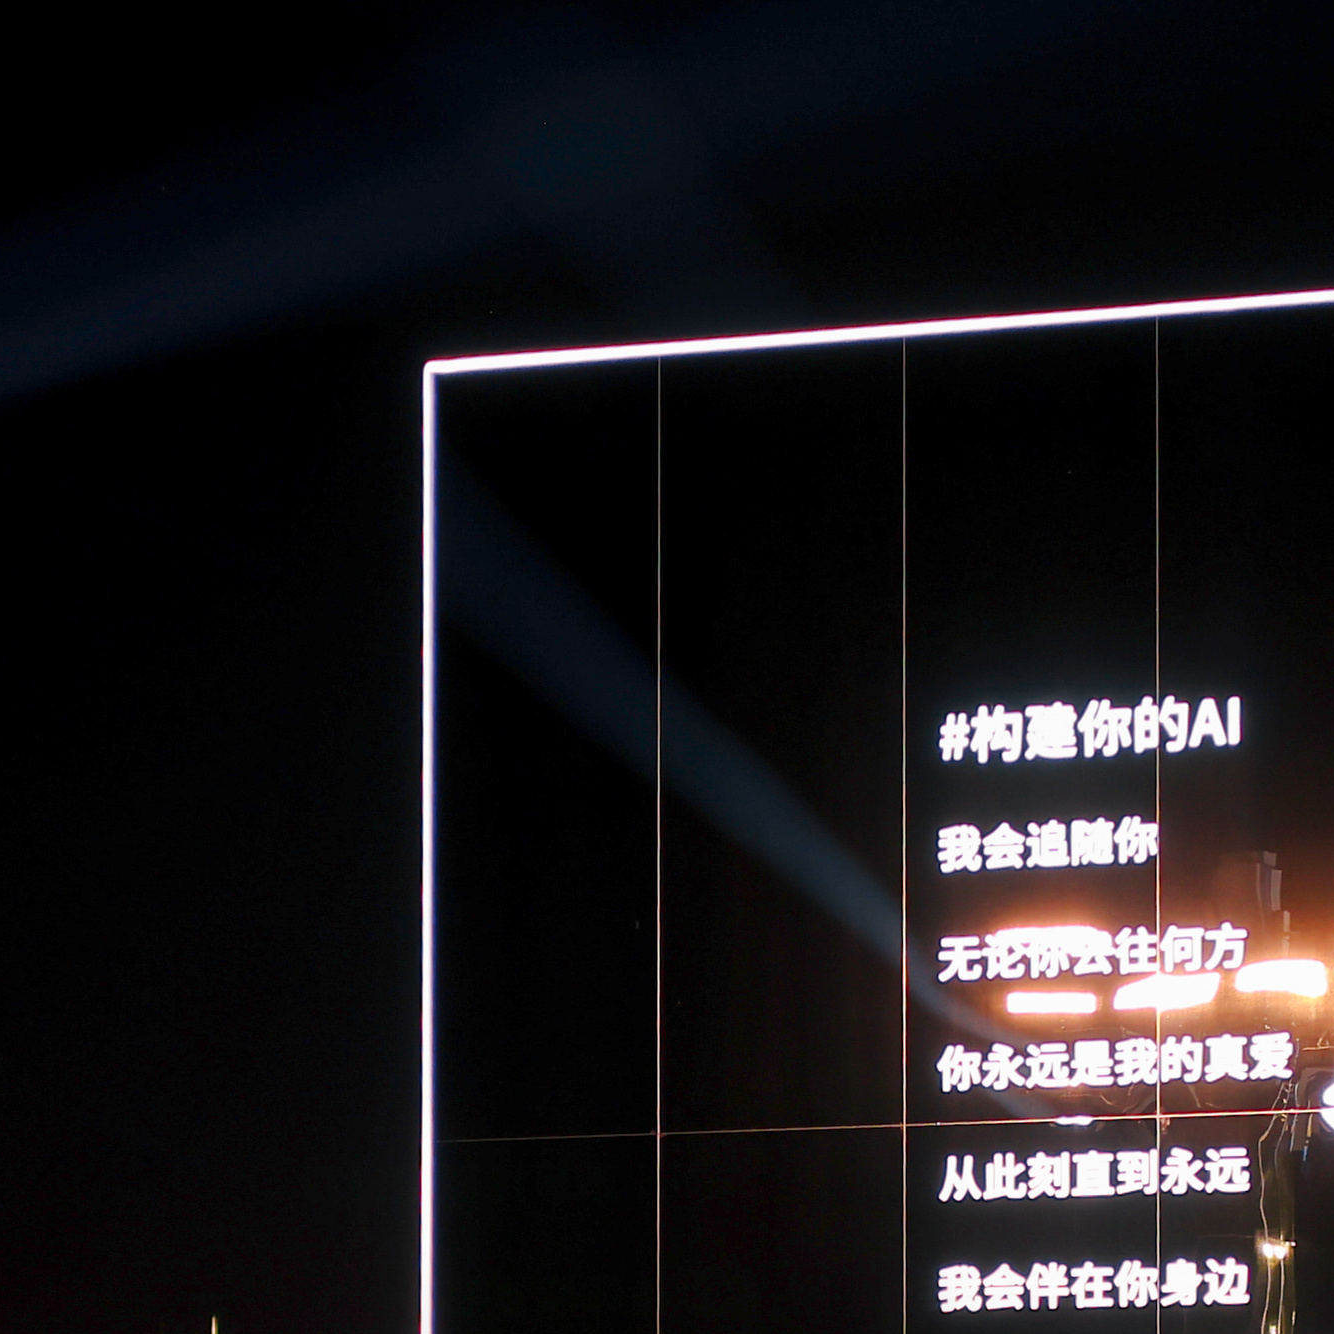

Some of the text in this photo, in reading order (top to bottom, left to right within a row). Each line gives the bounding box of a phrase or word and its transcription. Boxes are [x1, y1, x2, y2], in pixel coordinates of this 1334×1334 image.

[938, 695, 1243, 764] #构建你的AI
[937, 816, 1160, 873] 我会追随你
[937, 922, 1249, 983] 无论你去往何方
[936, 1032, 1294, 1093] 你永远是我的真爱
[937, 1146, 1251, 1202] 从此刻直到永远
[937, 1257, 1251, 1313] 我会伴在你身边
